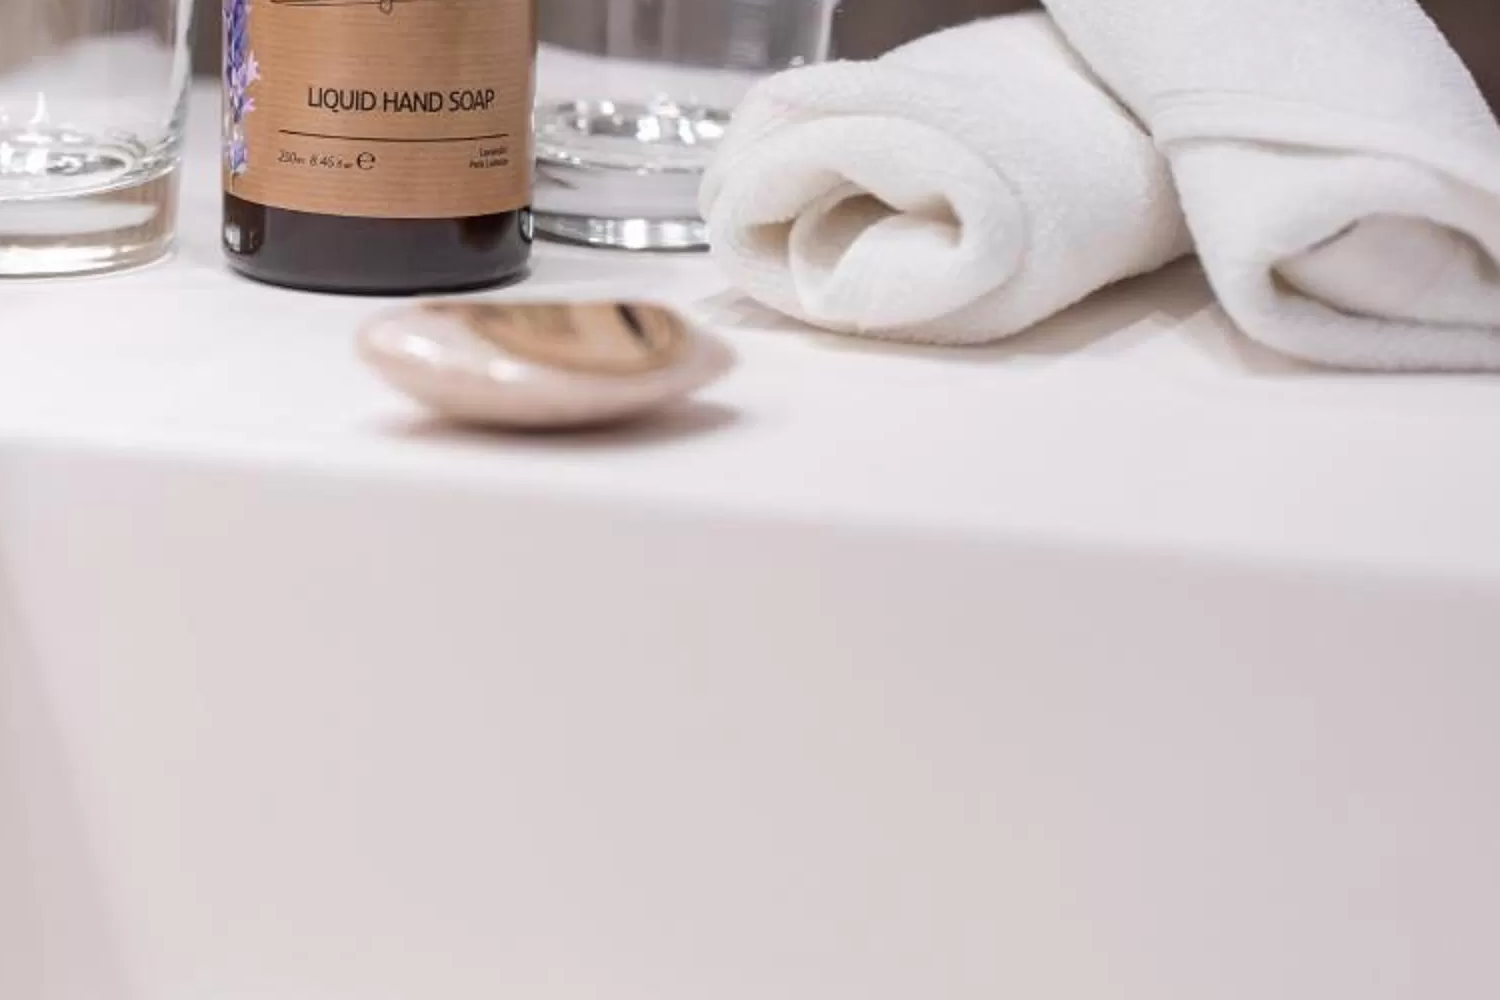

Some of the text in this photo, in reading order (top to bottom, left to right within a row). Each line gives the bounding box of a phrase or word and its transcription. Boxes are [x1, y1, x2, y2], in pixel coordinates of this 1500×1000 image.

[307, 87, 495, 114] LIQUID HAND SOAP
